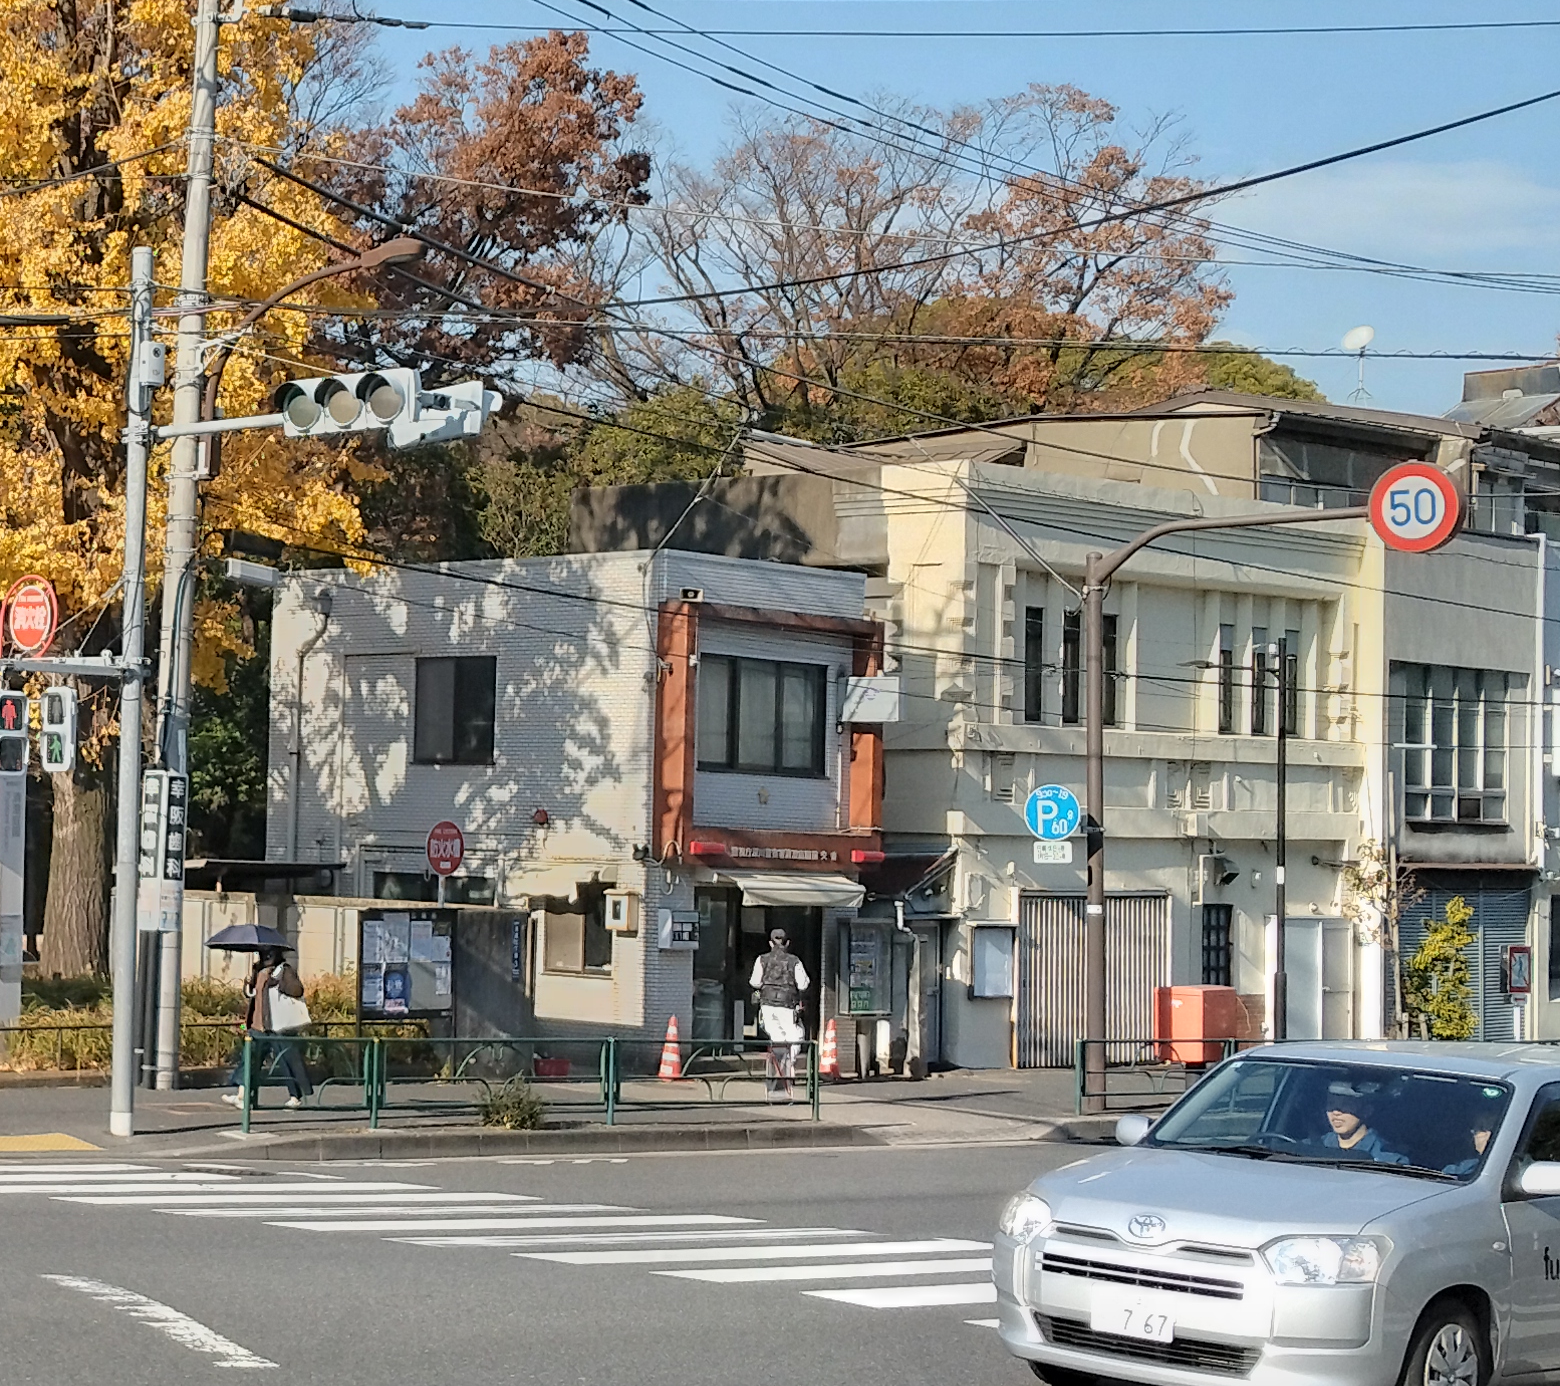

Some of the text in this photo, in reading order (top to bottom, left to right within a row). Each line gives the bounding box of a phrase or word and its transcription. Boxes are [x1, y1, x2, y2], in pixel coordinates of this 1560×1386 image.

[1390, 488, 1437, 527] 50
[13, 605, 48, 631] 消火栓
[166, 779, 185, 878] 幸阪歯科
[1037, 799, 1058, 835] P
